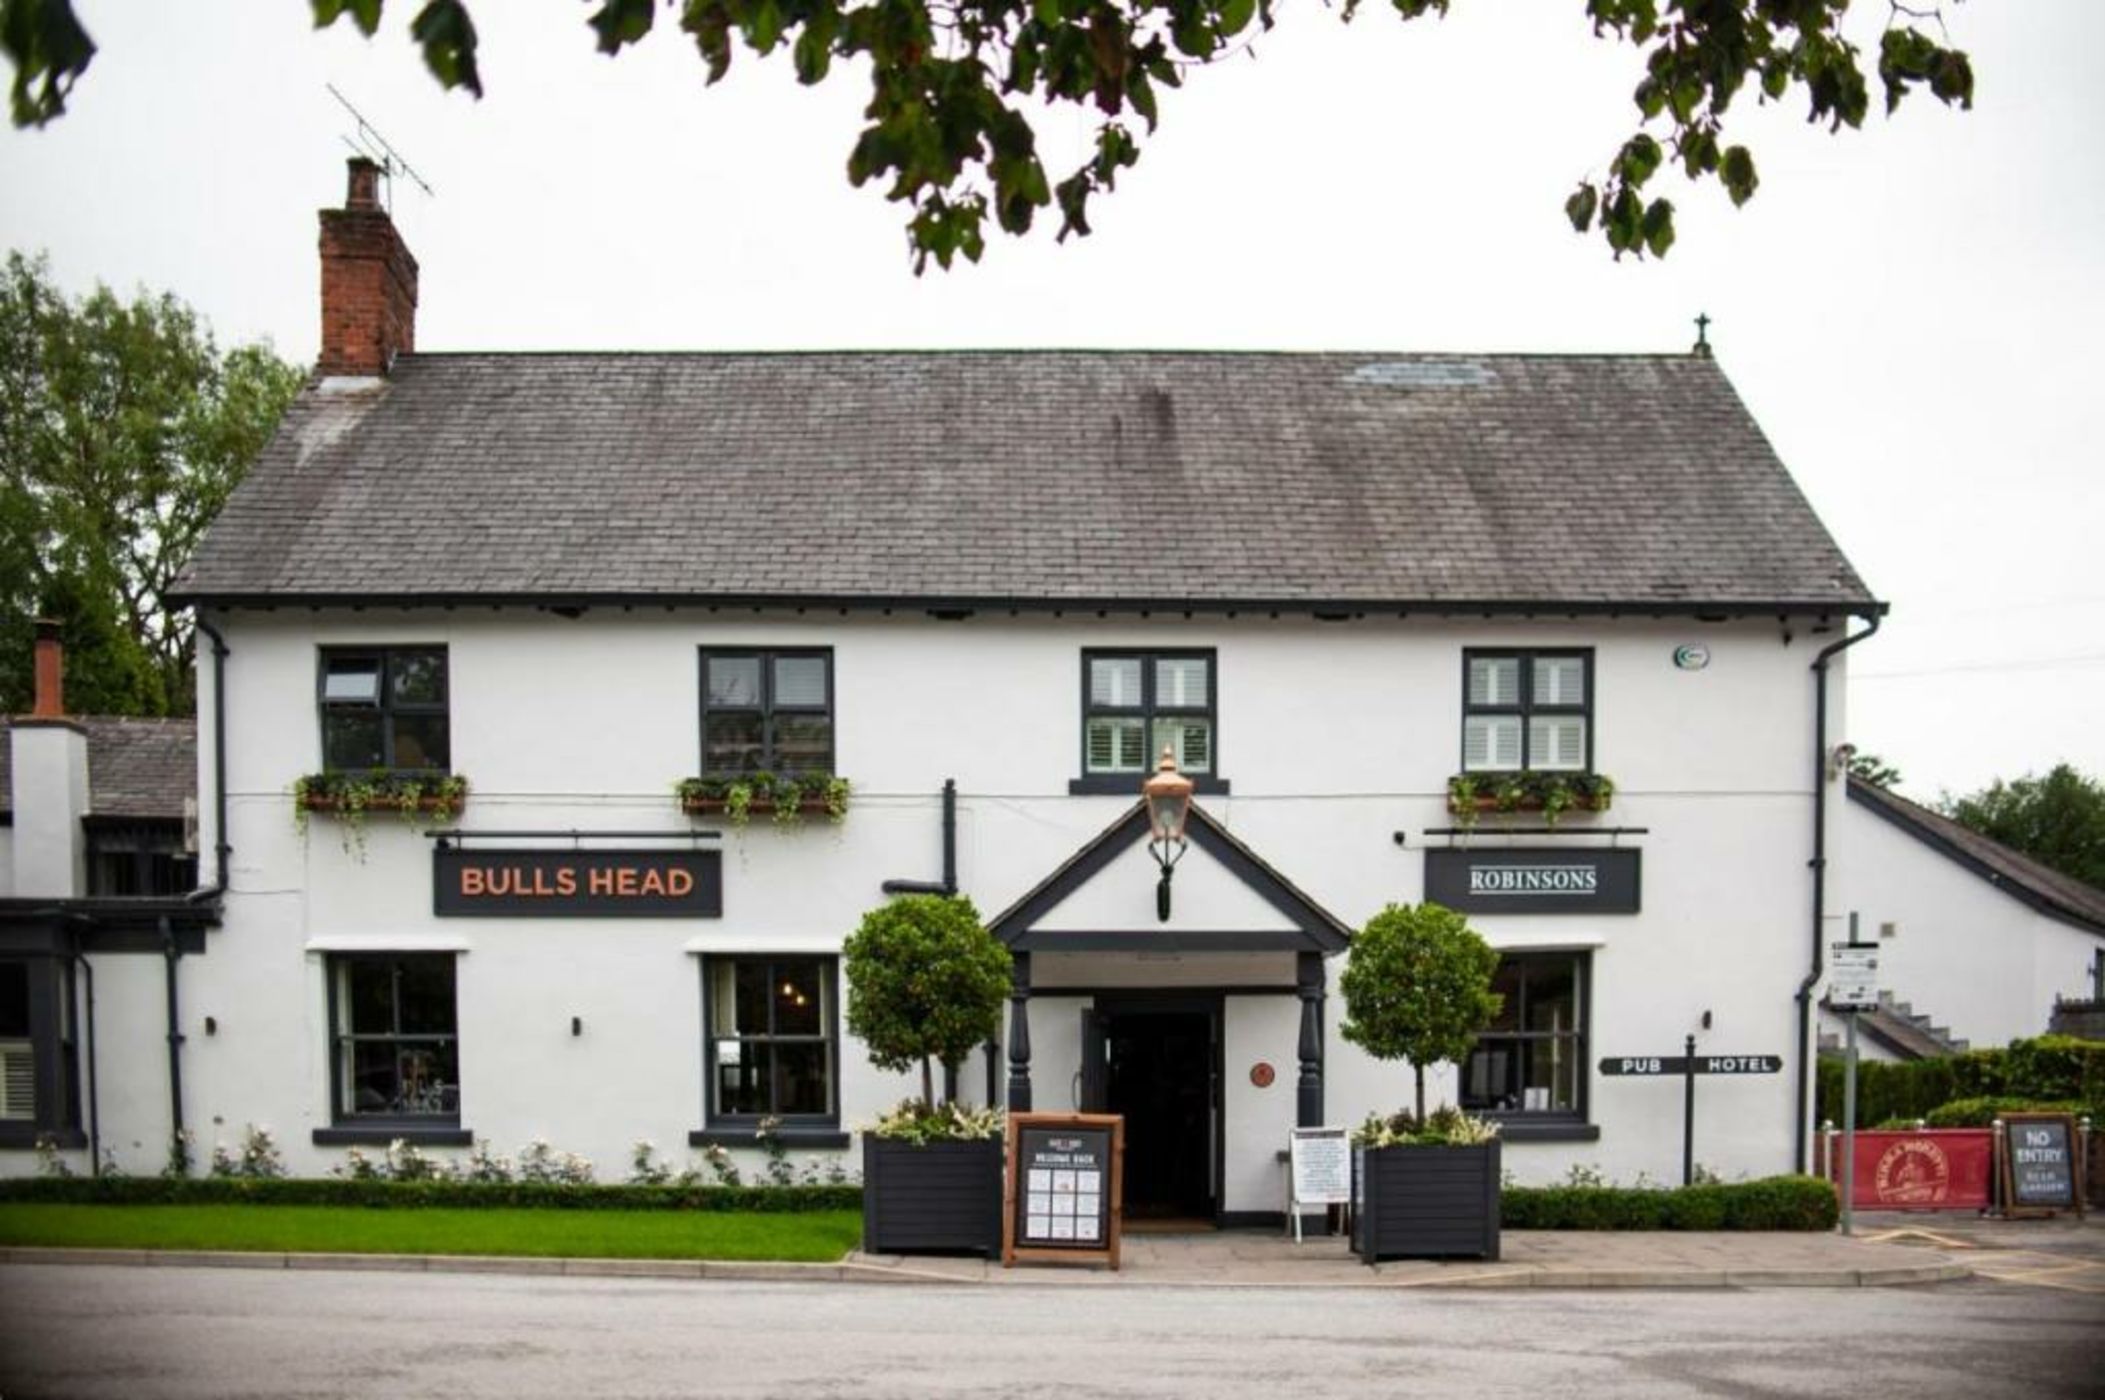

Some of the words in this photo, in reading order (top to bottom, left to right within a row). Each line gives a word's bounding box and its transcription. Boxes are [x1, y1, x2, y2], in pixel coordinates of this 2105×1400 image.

[461, 867, 577, 895] BULLS
[588, 868, 693, 895] HEAD
[1470, 870, 1597, 889] ROBINSONS
[1622, 1059, 1661, 1072] PUB
[1709, 1057, 1771, 1072] HOTEL
[2026, 1130, 2050, 1147] NO
[2017, 1148, 2061, 1163] ENTRY
